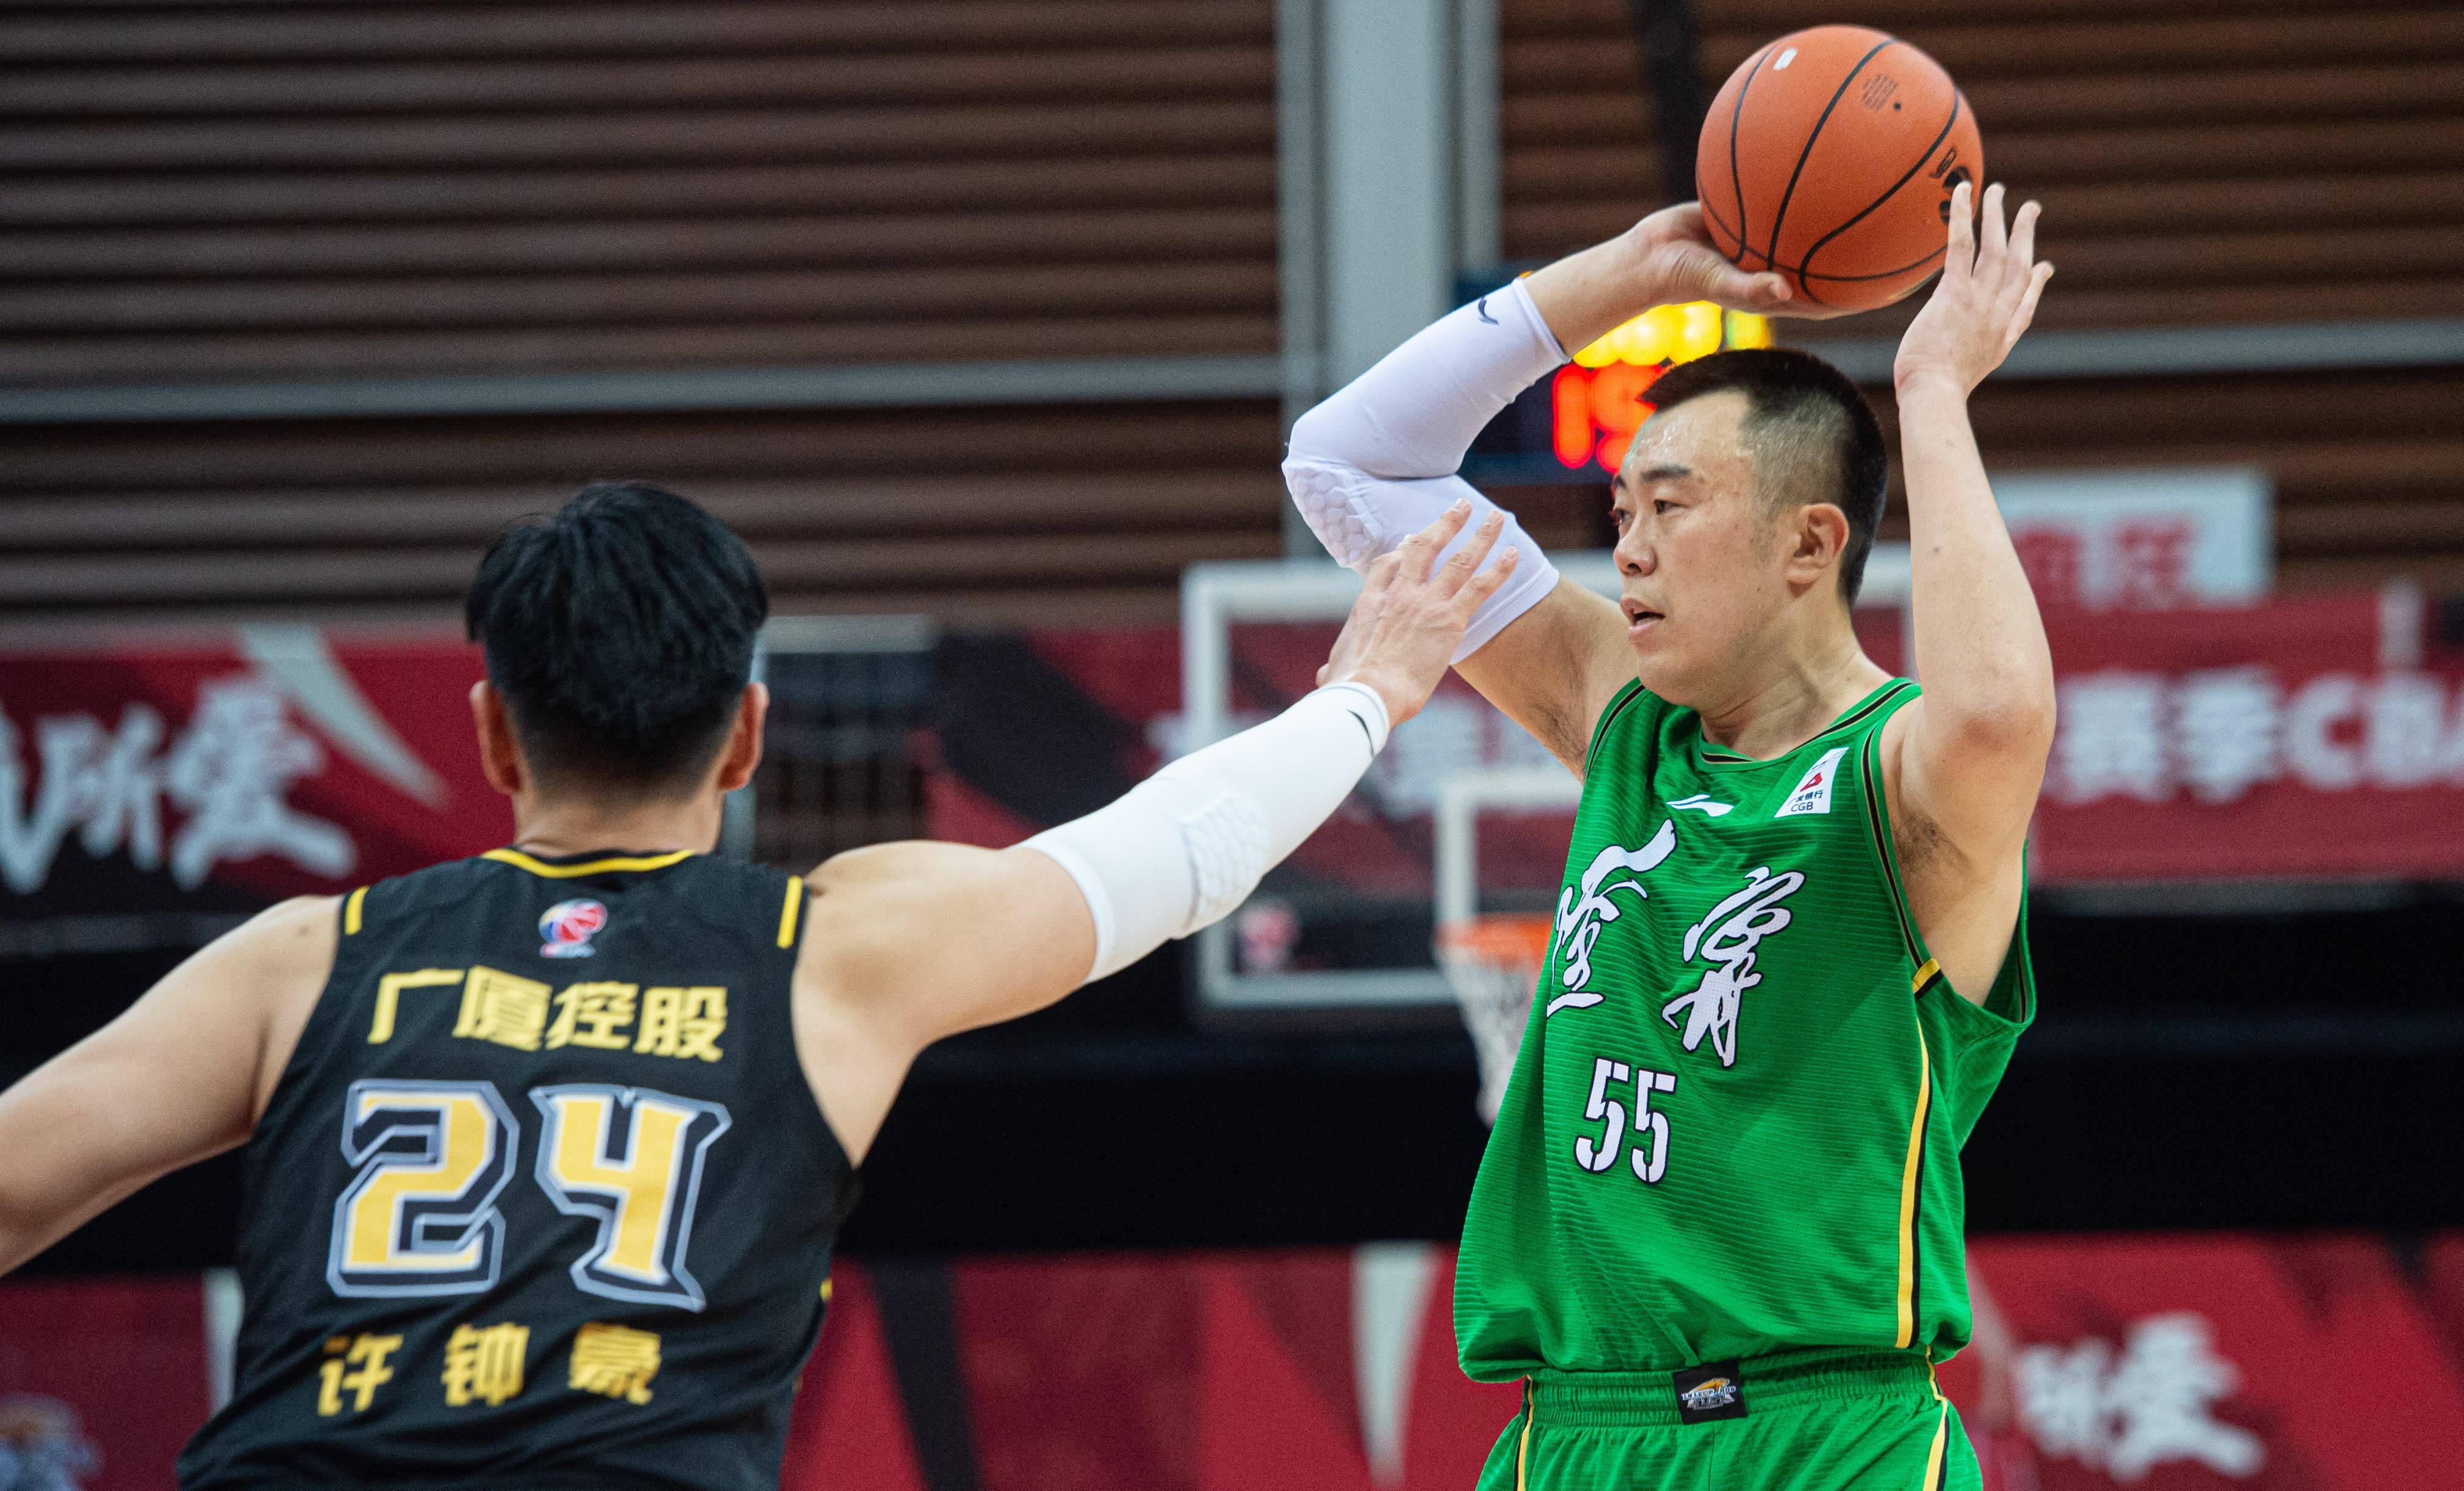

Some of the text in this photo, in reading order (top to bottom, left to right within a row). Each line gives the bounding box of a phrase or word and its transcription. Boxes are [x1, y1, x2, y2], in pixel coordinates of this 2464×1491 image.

[1791, 801, 1814, 812] CGB
[368, 964, 729, 1062] 广厦控股
[1573, 1056, 1677, 1186] 55
[326, 1078, 732, 1313] 24
